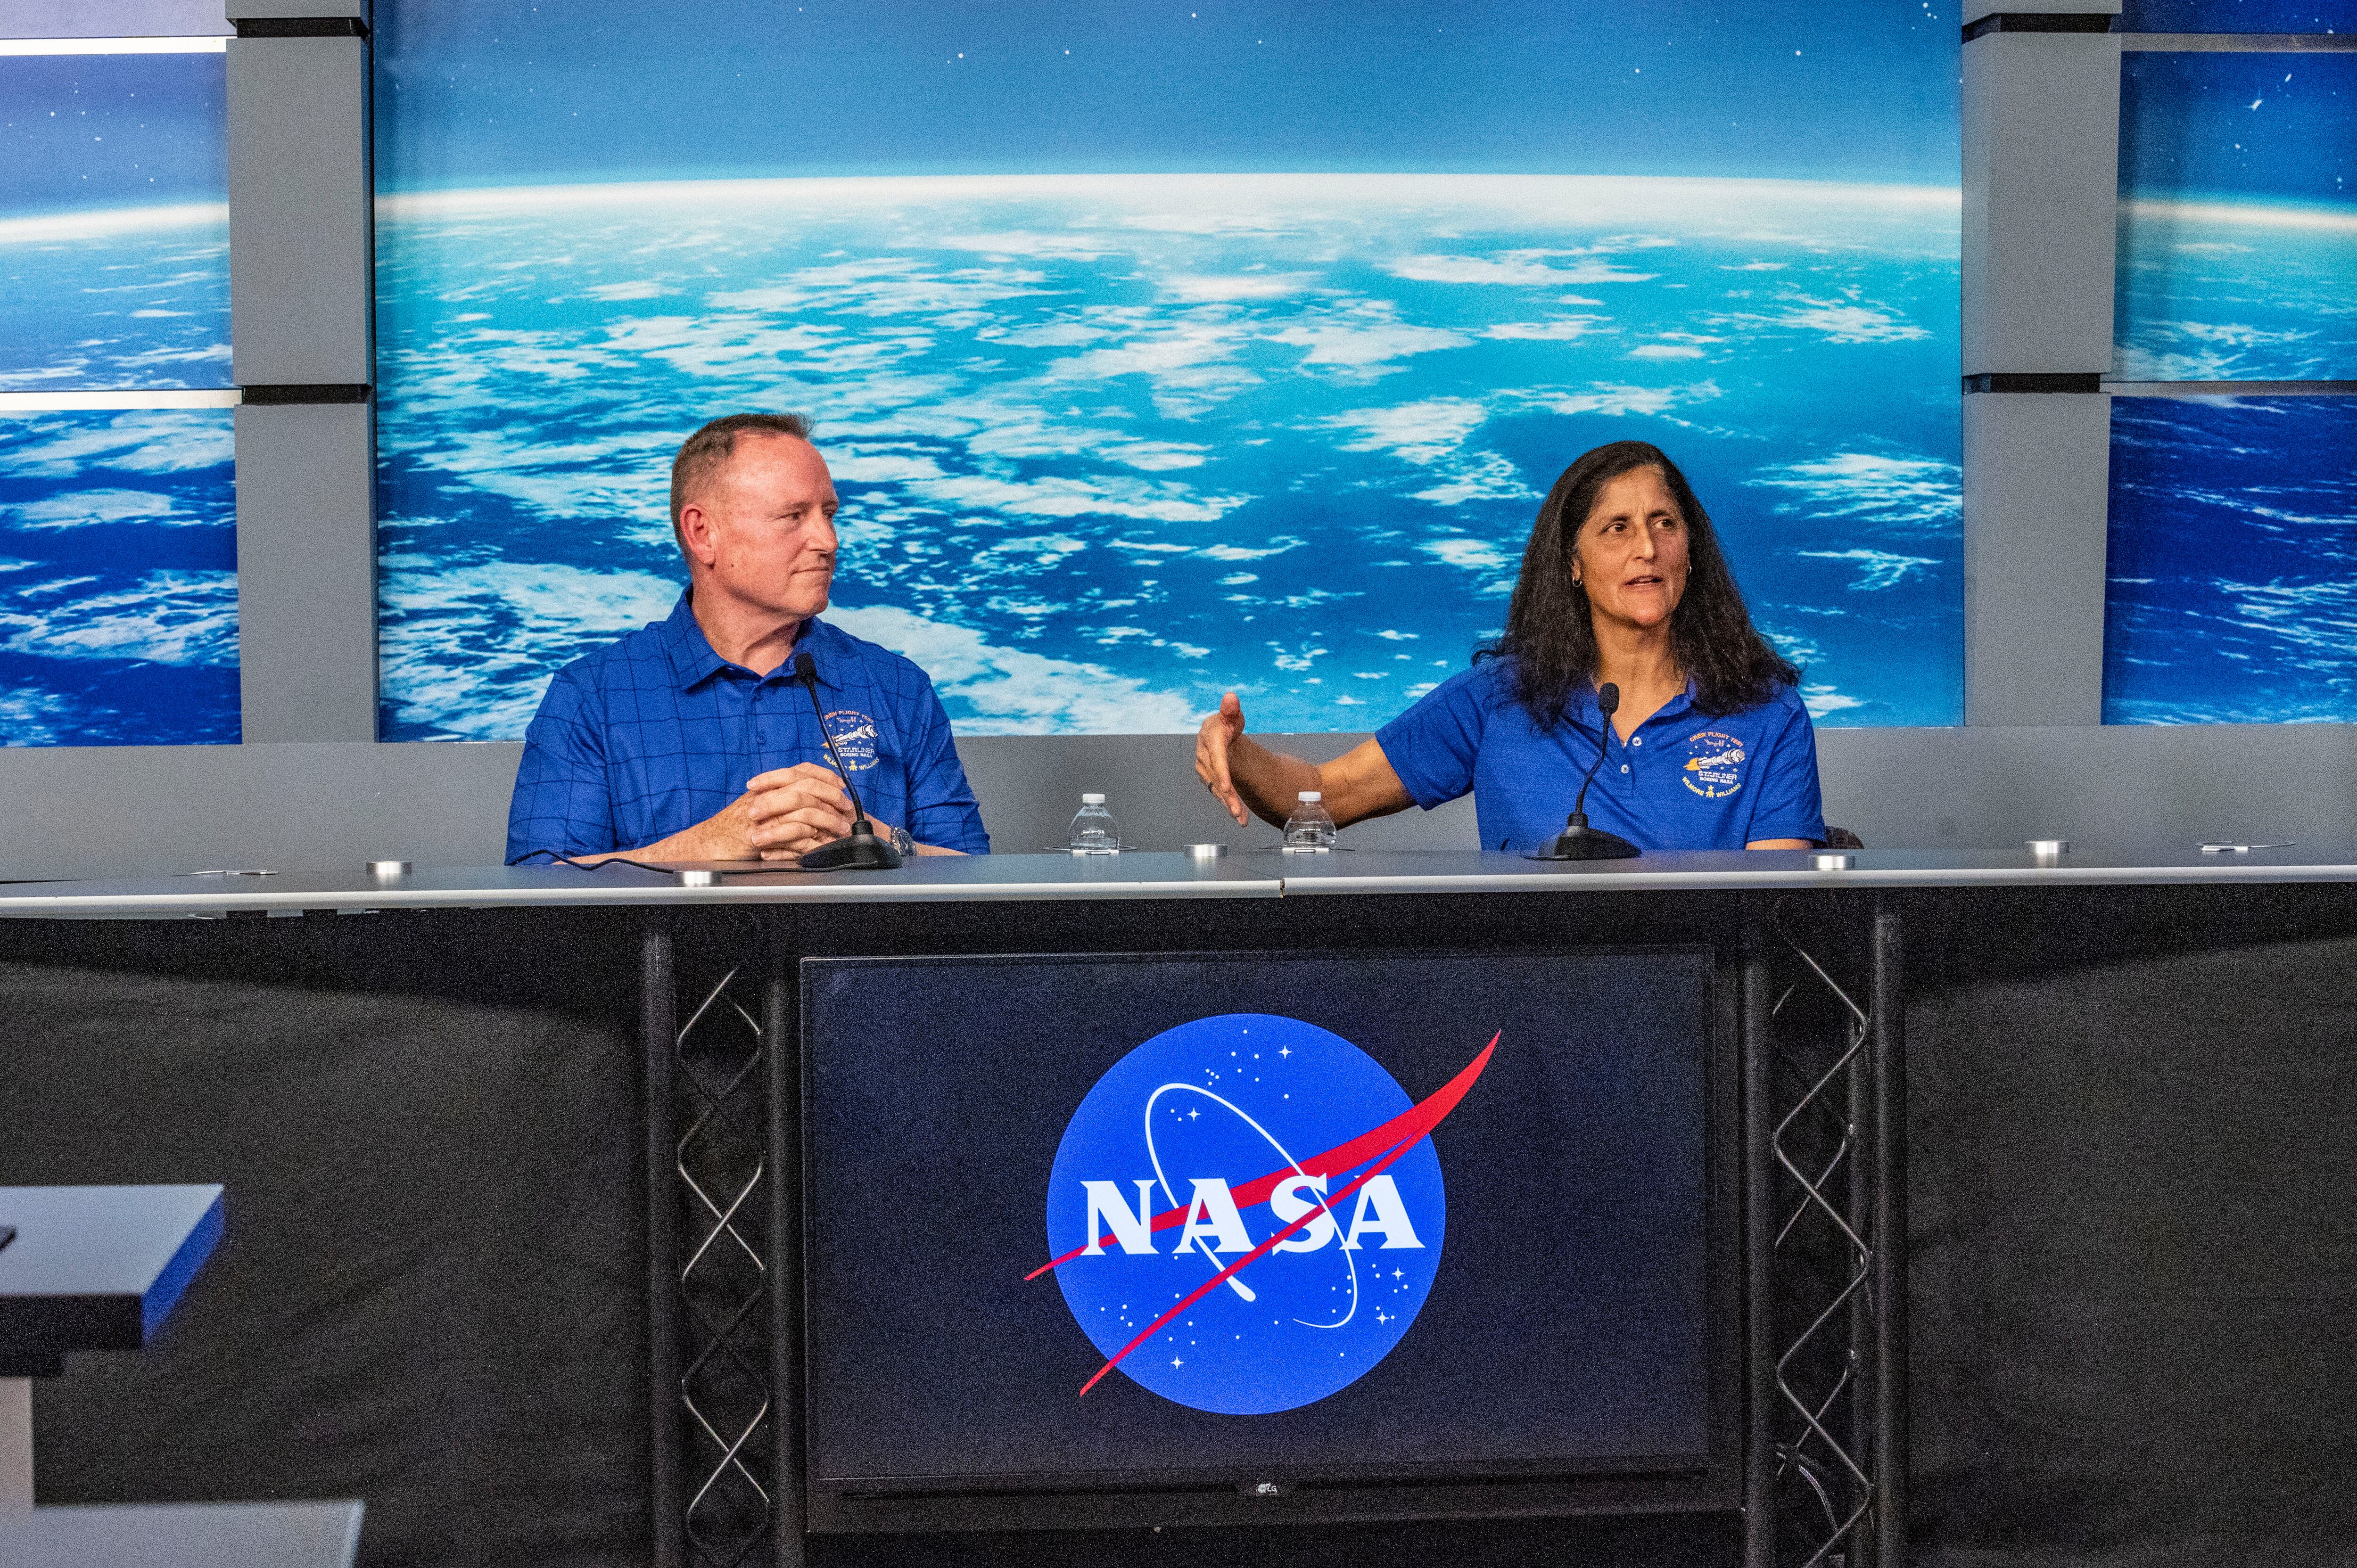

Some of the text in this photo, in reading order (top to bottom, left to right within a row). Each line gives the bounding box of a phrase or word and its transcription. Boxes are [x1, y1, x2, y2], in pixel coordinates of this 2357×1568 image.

[861, 714, 874, 723] TEST
[1689, 732, 1706, 742] CREW
[1731, 738, 1743, 747] TEST
[859, 757, 880, 770] WILLIAMS
[1698, 770, 1737, 780] STARLINER
[1681, 776, 1705, 796] WILMORE
[1716, 783, 1741, 797] WILLIAMS
[1080, 1173, 1426, 1256] NASA
